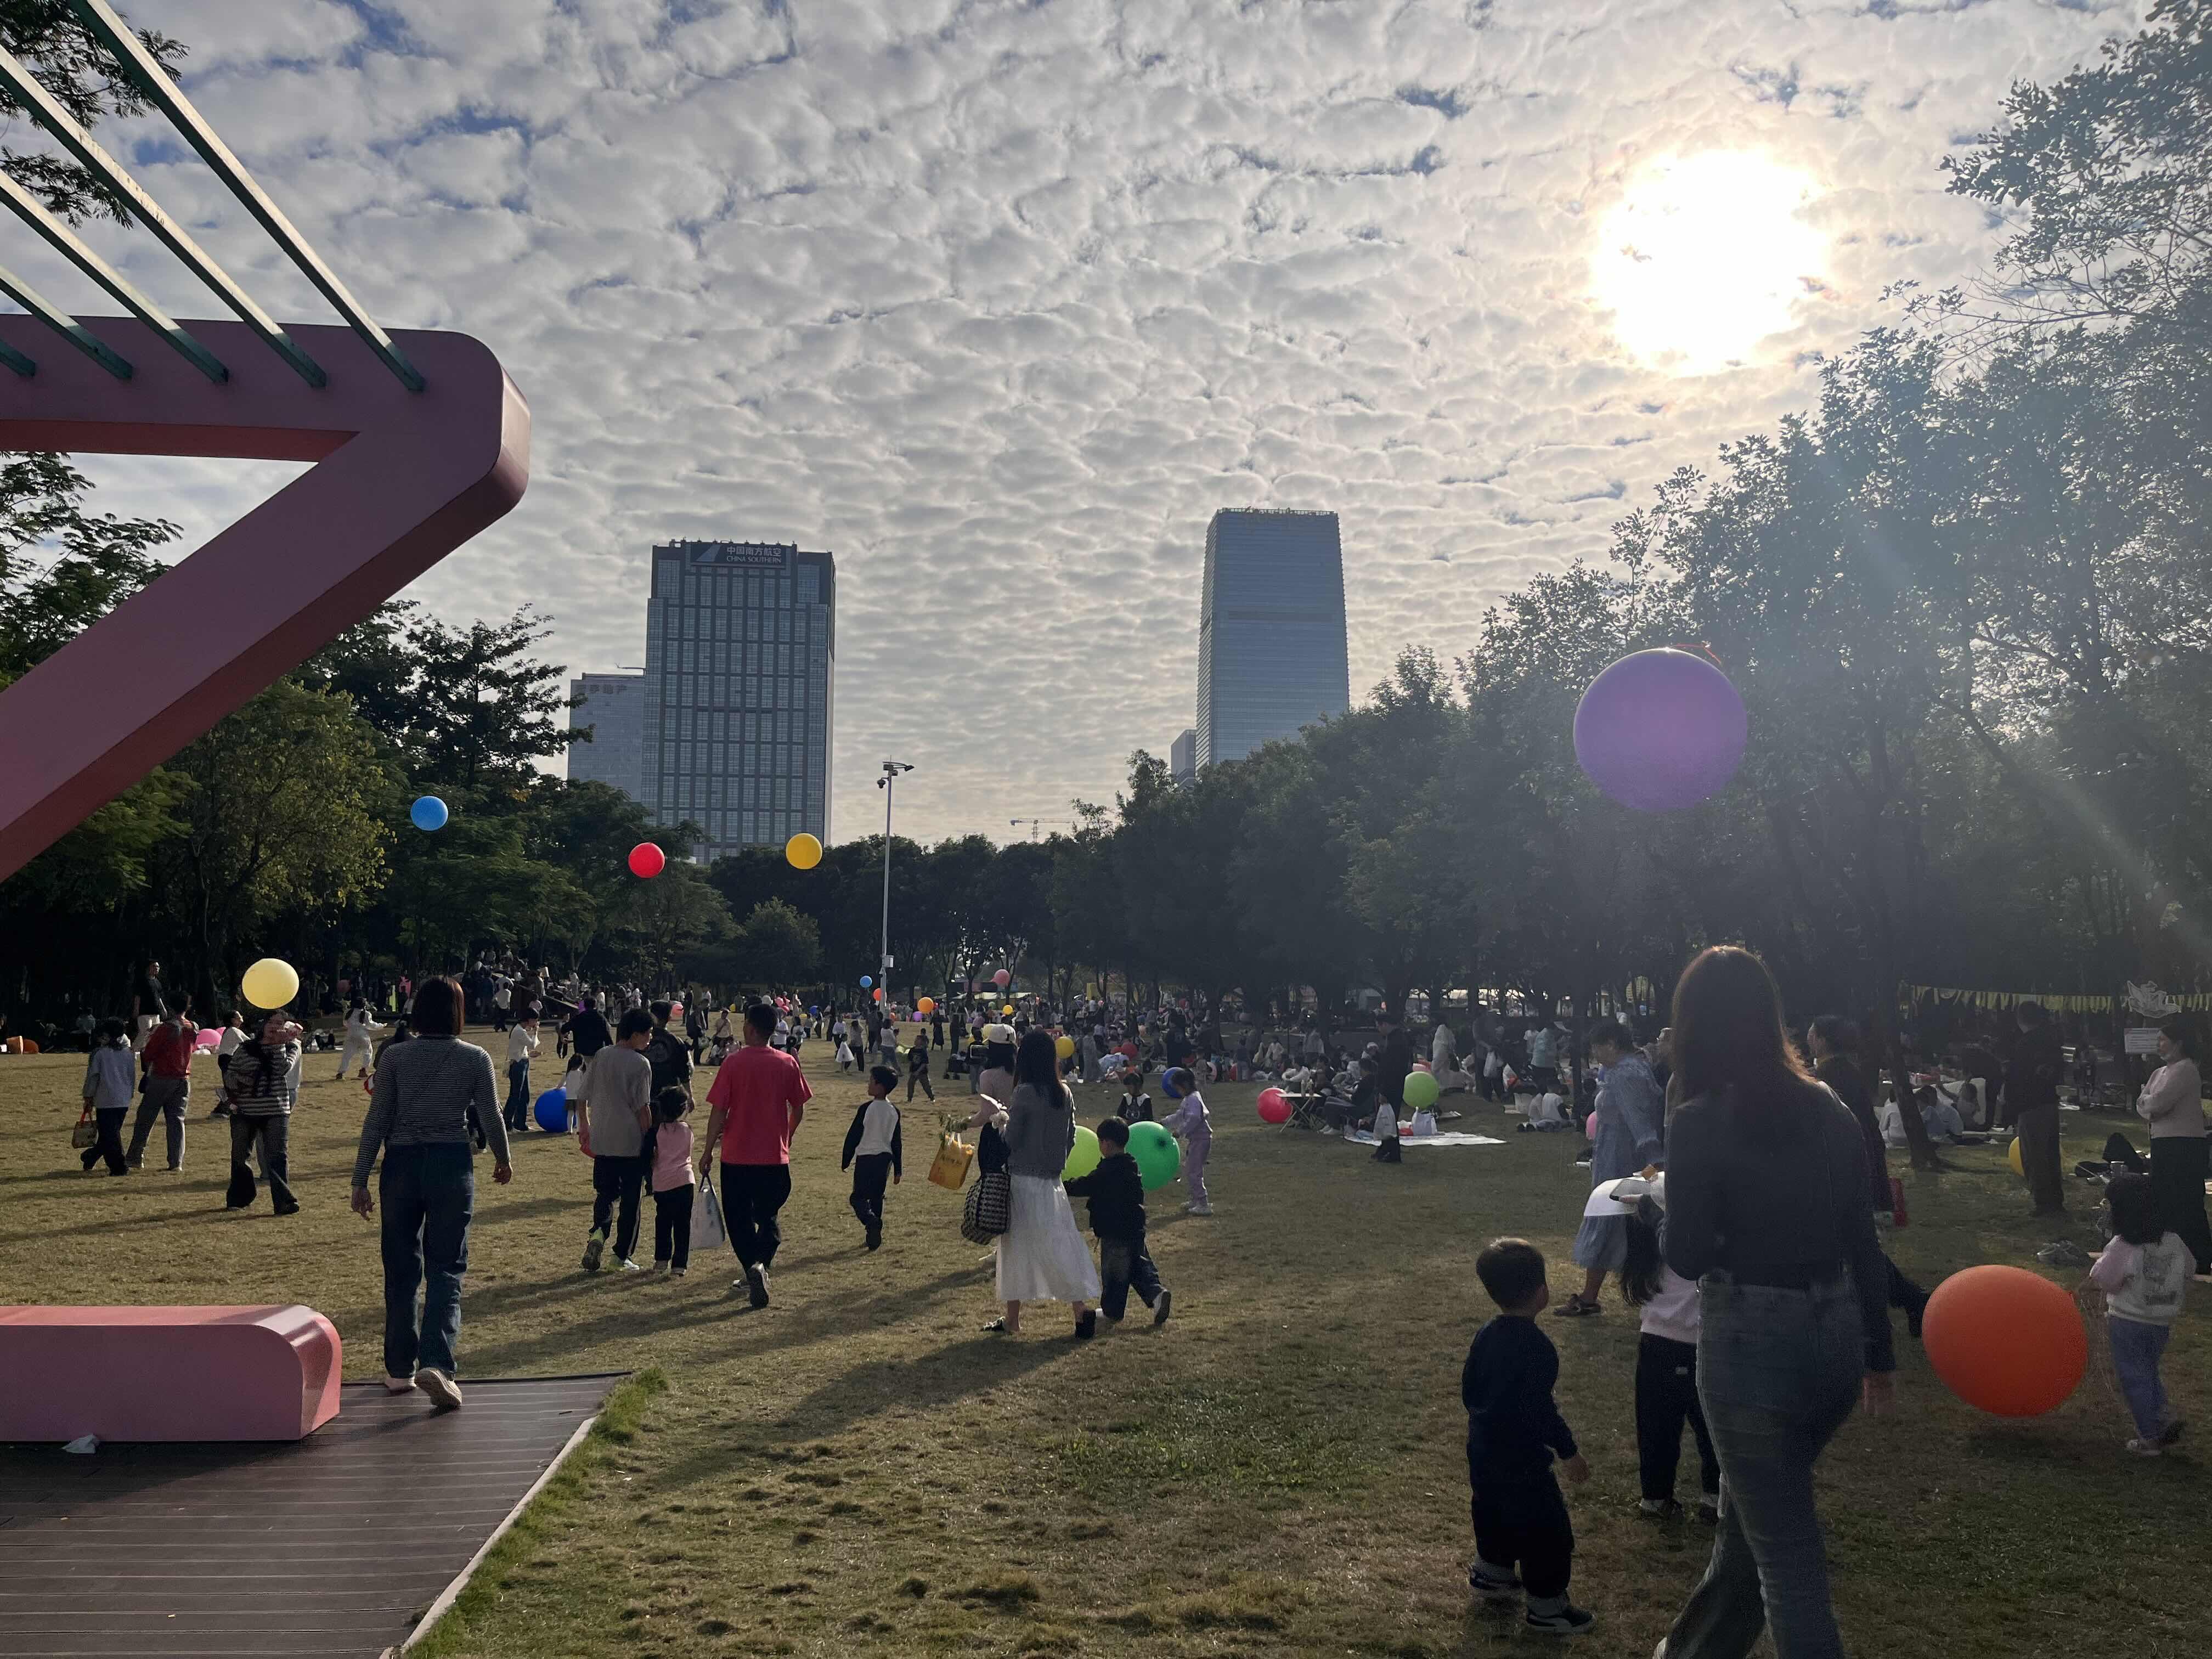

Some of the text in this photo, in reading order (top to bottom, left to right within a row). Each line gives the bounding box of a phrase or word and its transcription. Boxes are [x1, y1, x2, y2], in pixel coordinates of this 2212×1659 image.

[726, 546, 782, 557] 中国南方航空
